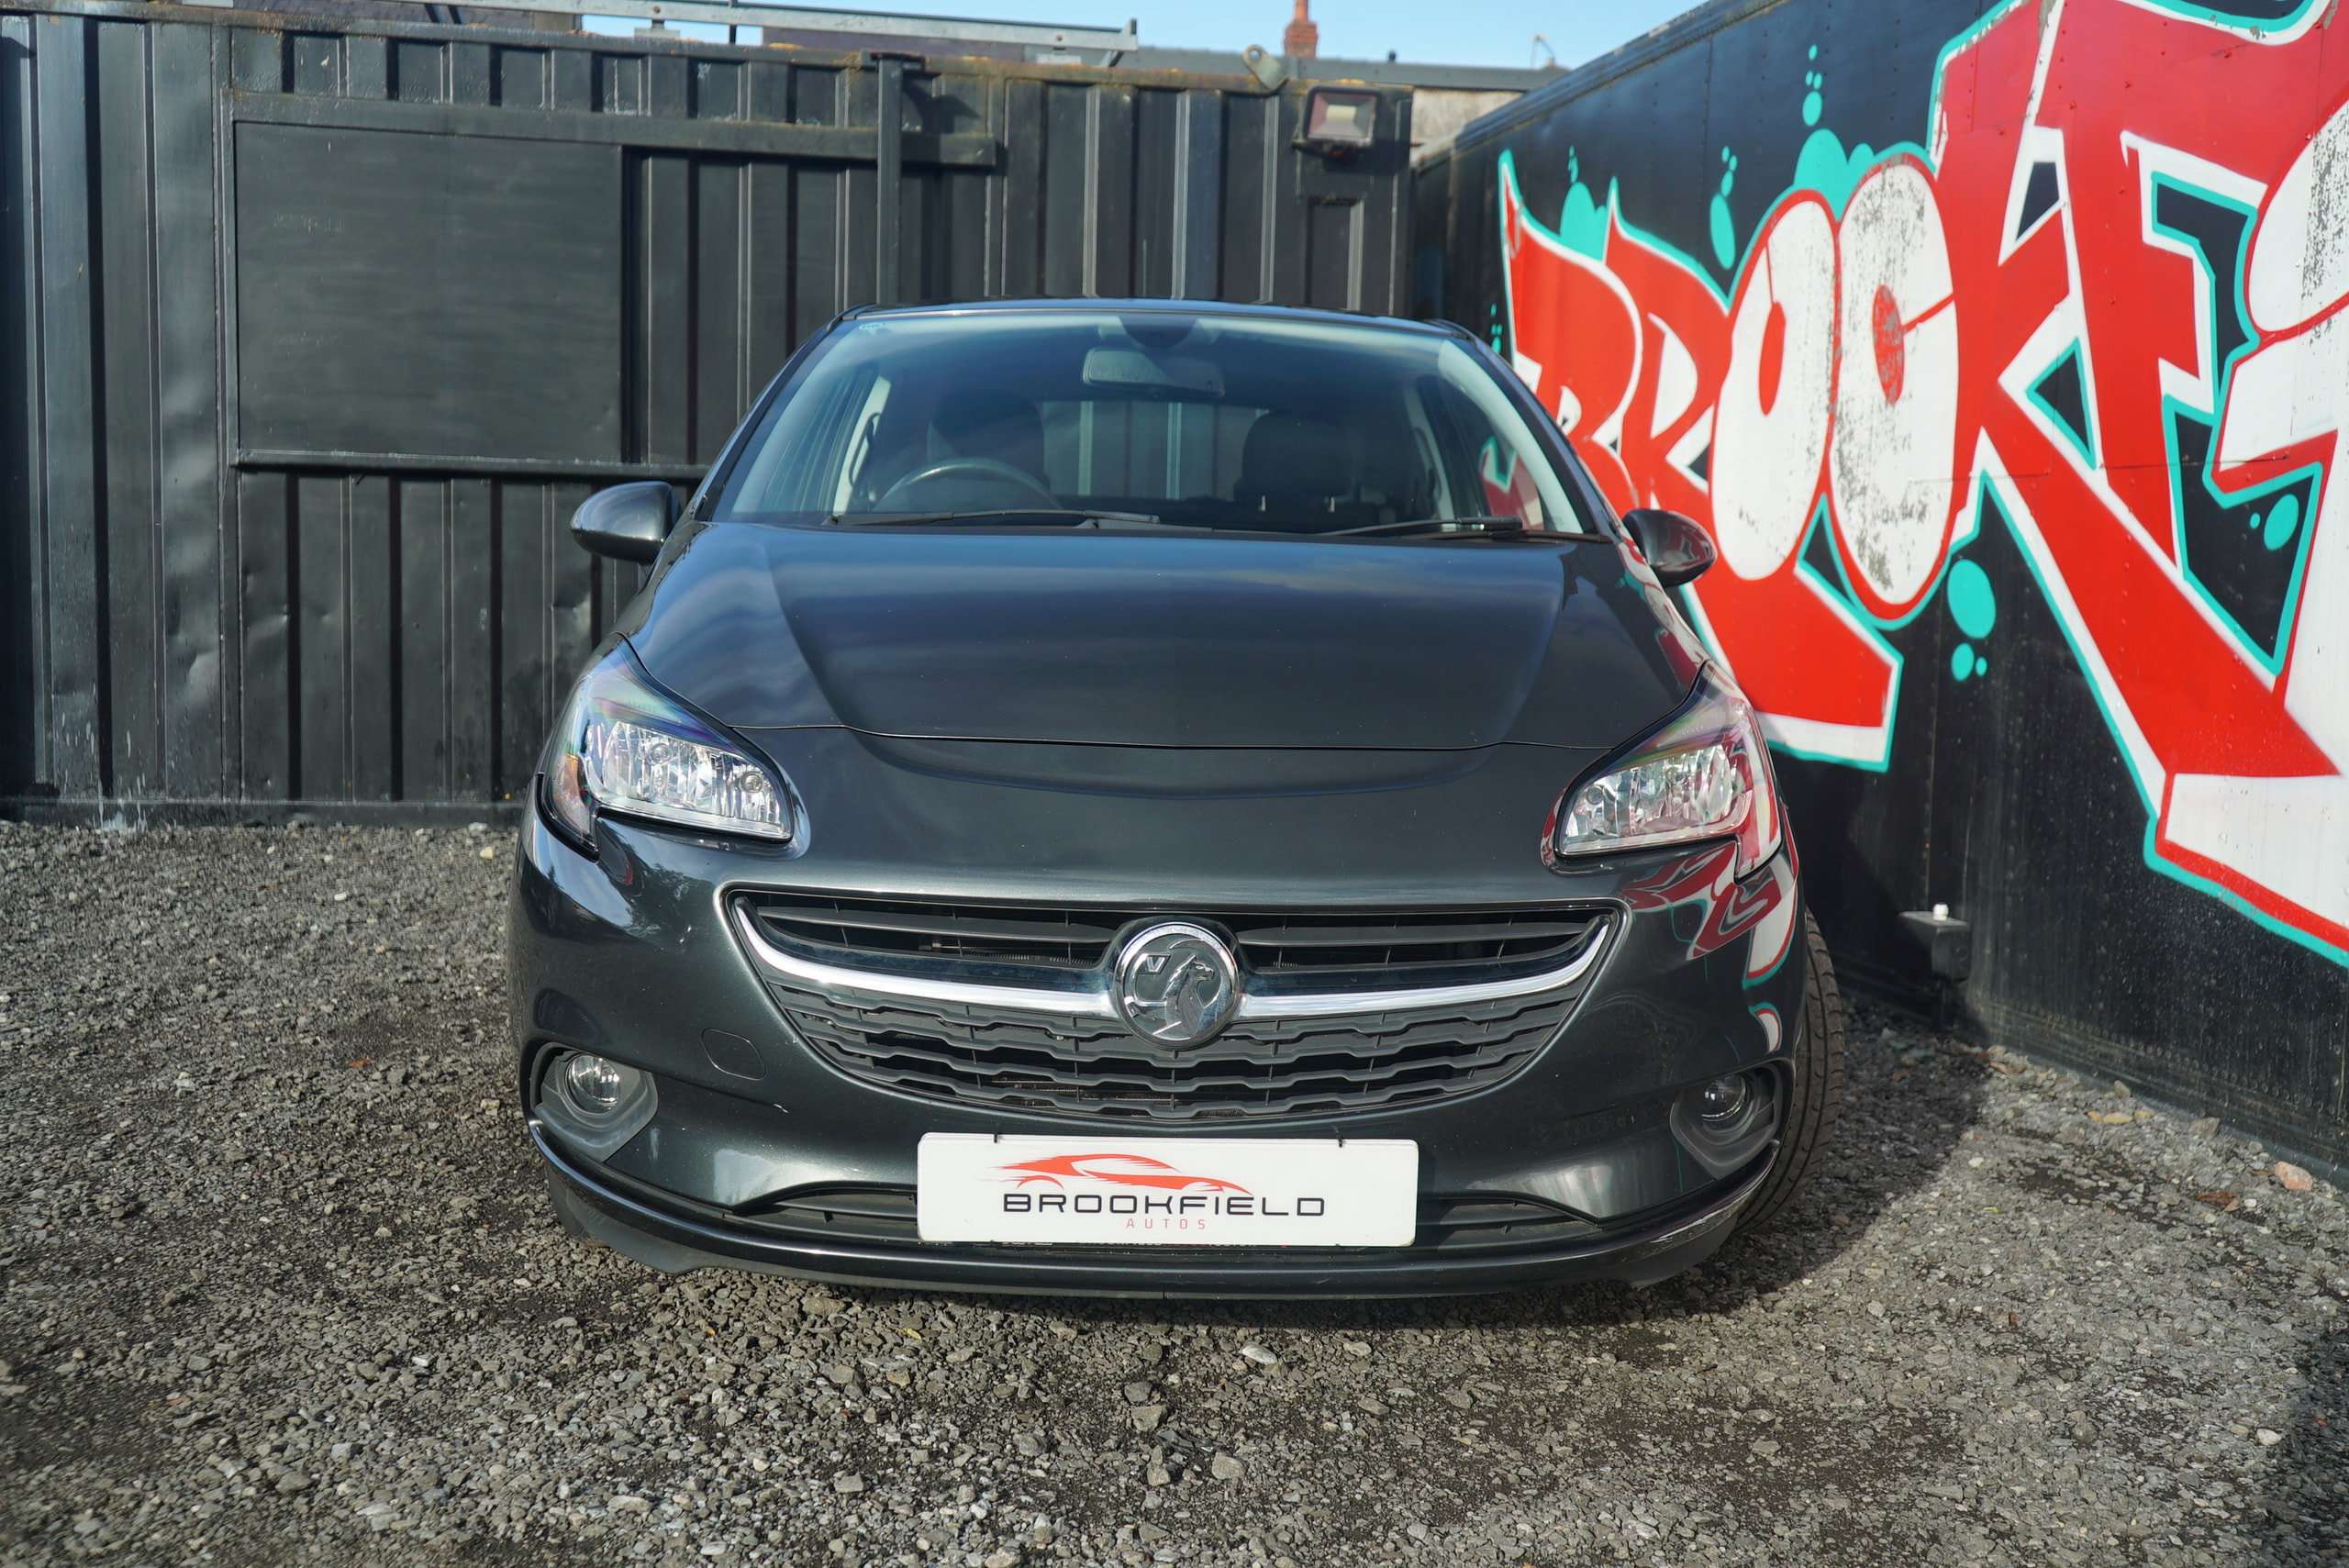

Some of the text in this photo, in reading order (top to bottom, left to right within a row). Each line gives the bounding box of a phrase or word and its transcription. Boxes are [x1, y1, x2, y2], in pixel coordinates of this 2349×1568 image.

[1145, 956, 1166, 973] V
[1003, 1193, 1325, 1217] BROOKFIELD
[1125, 1218, 1206, 1230] AUTOS
